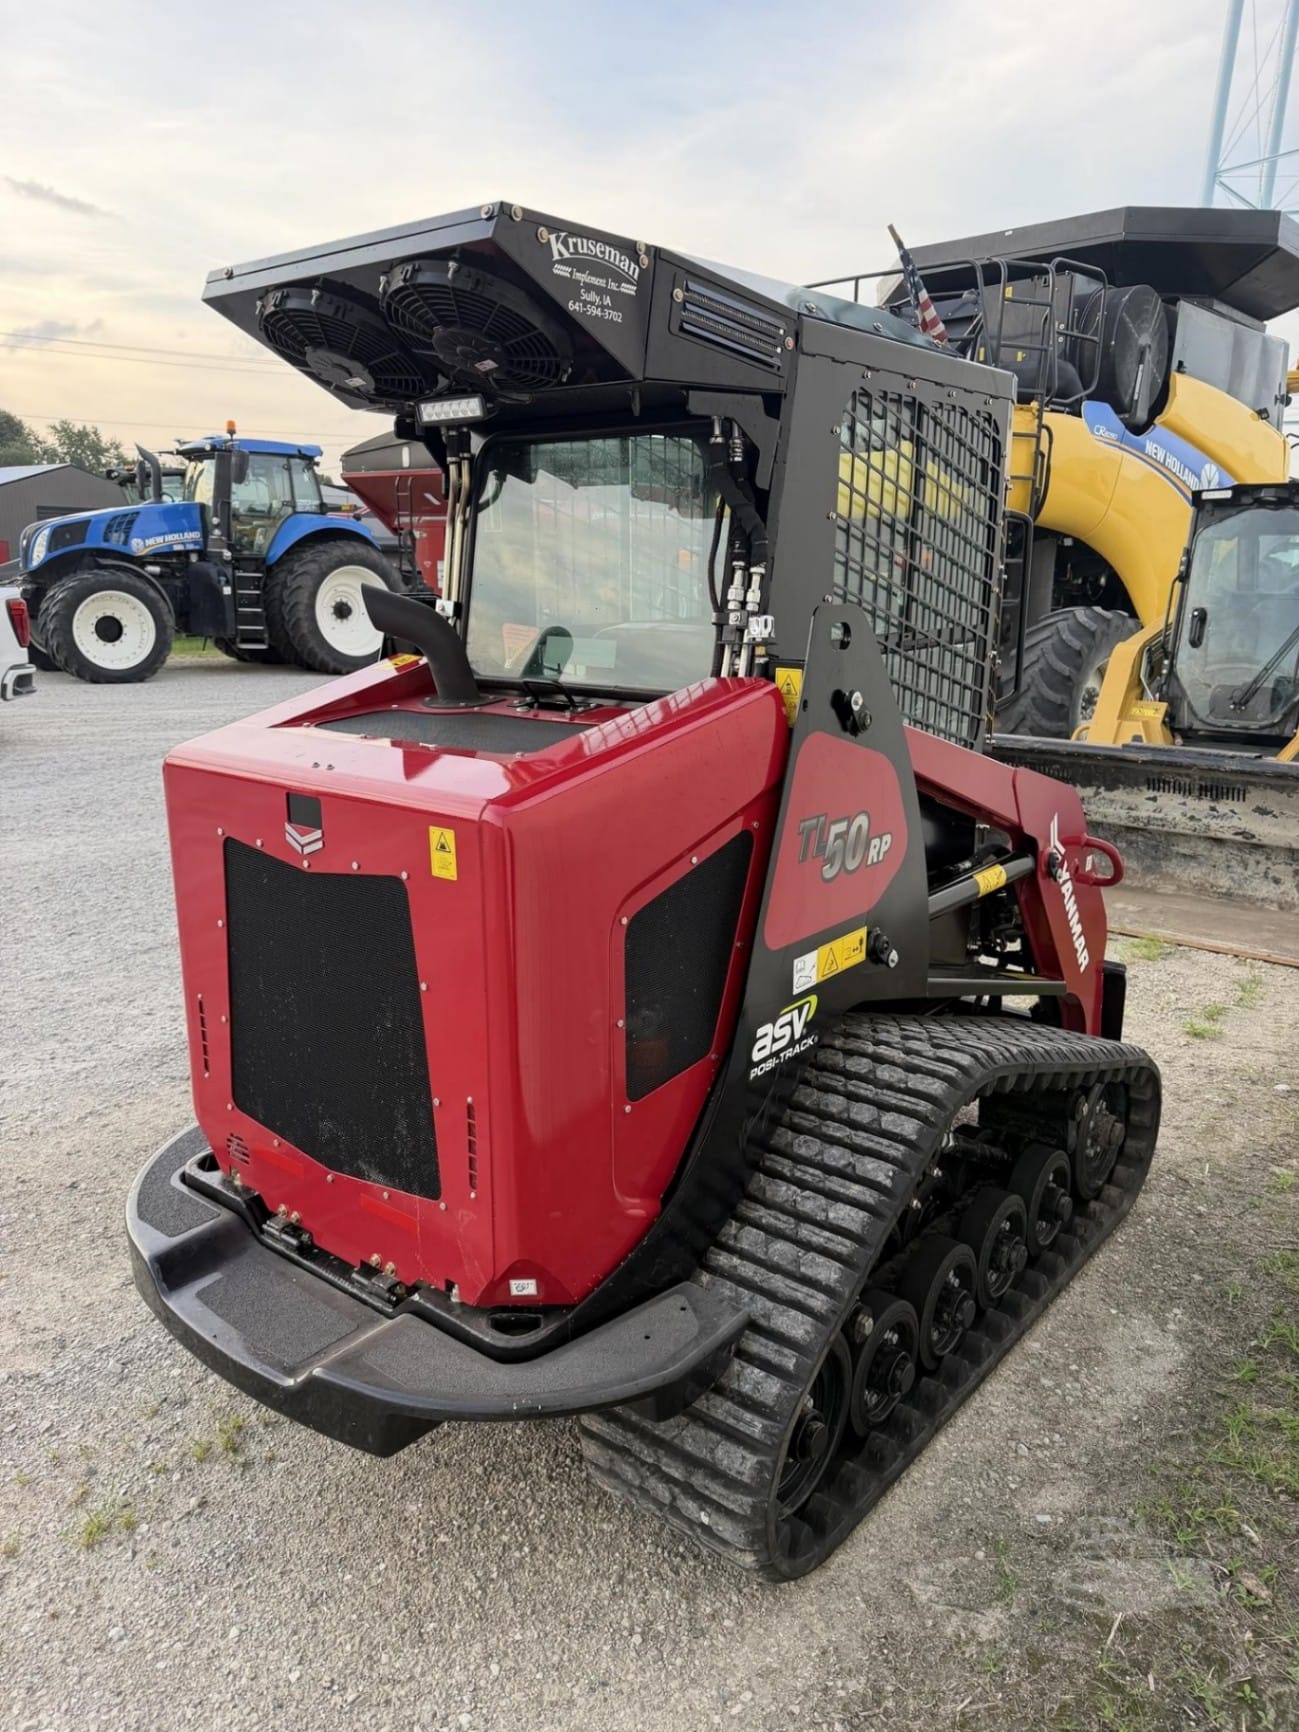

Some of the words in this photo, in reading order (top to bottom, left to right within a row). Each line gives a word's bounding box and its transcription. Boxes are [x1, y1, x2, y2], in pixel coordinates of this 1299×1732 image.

[549, 232, 640, 280] Kruseman
[572, 268, 607, 286] Implement
[580, 289, 602, 306] Sully,
[603, 294, 612, 307] IA
[568, 300, 623, 323] 641-594-3702
[1145, 440, 1166, 463] NEW
[1165, 450, 1200, 491] HOLLAND
[145, 535, 164, 547] NEW
[164, 531, 201, 543] HOLLAND
